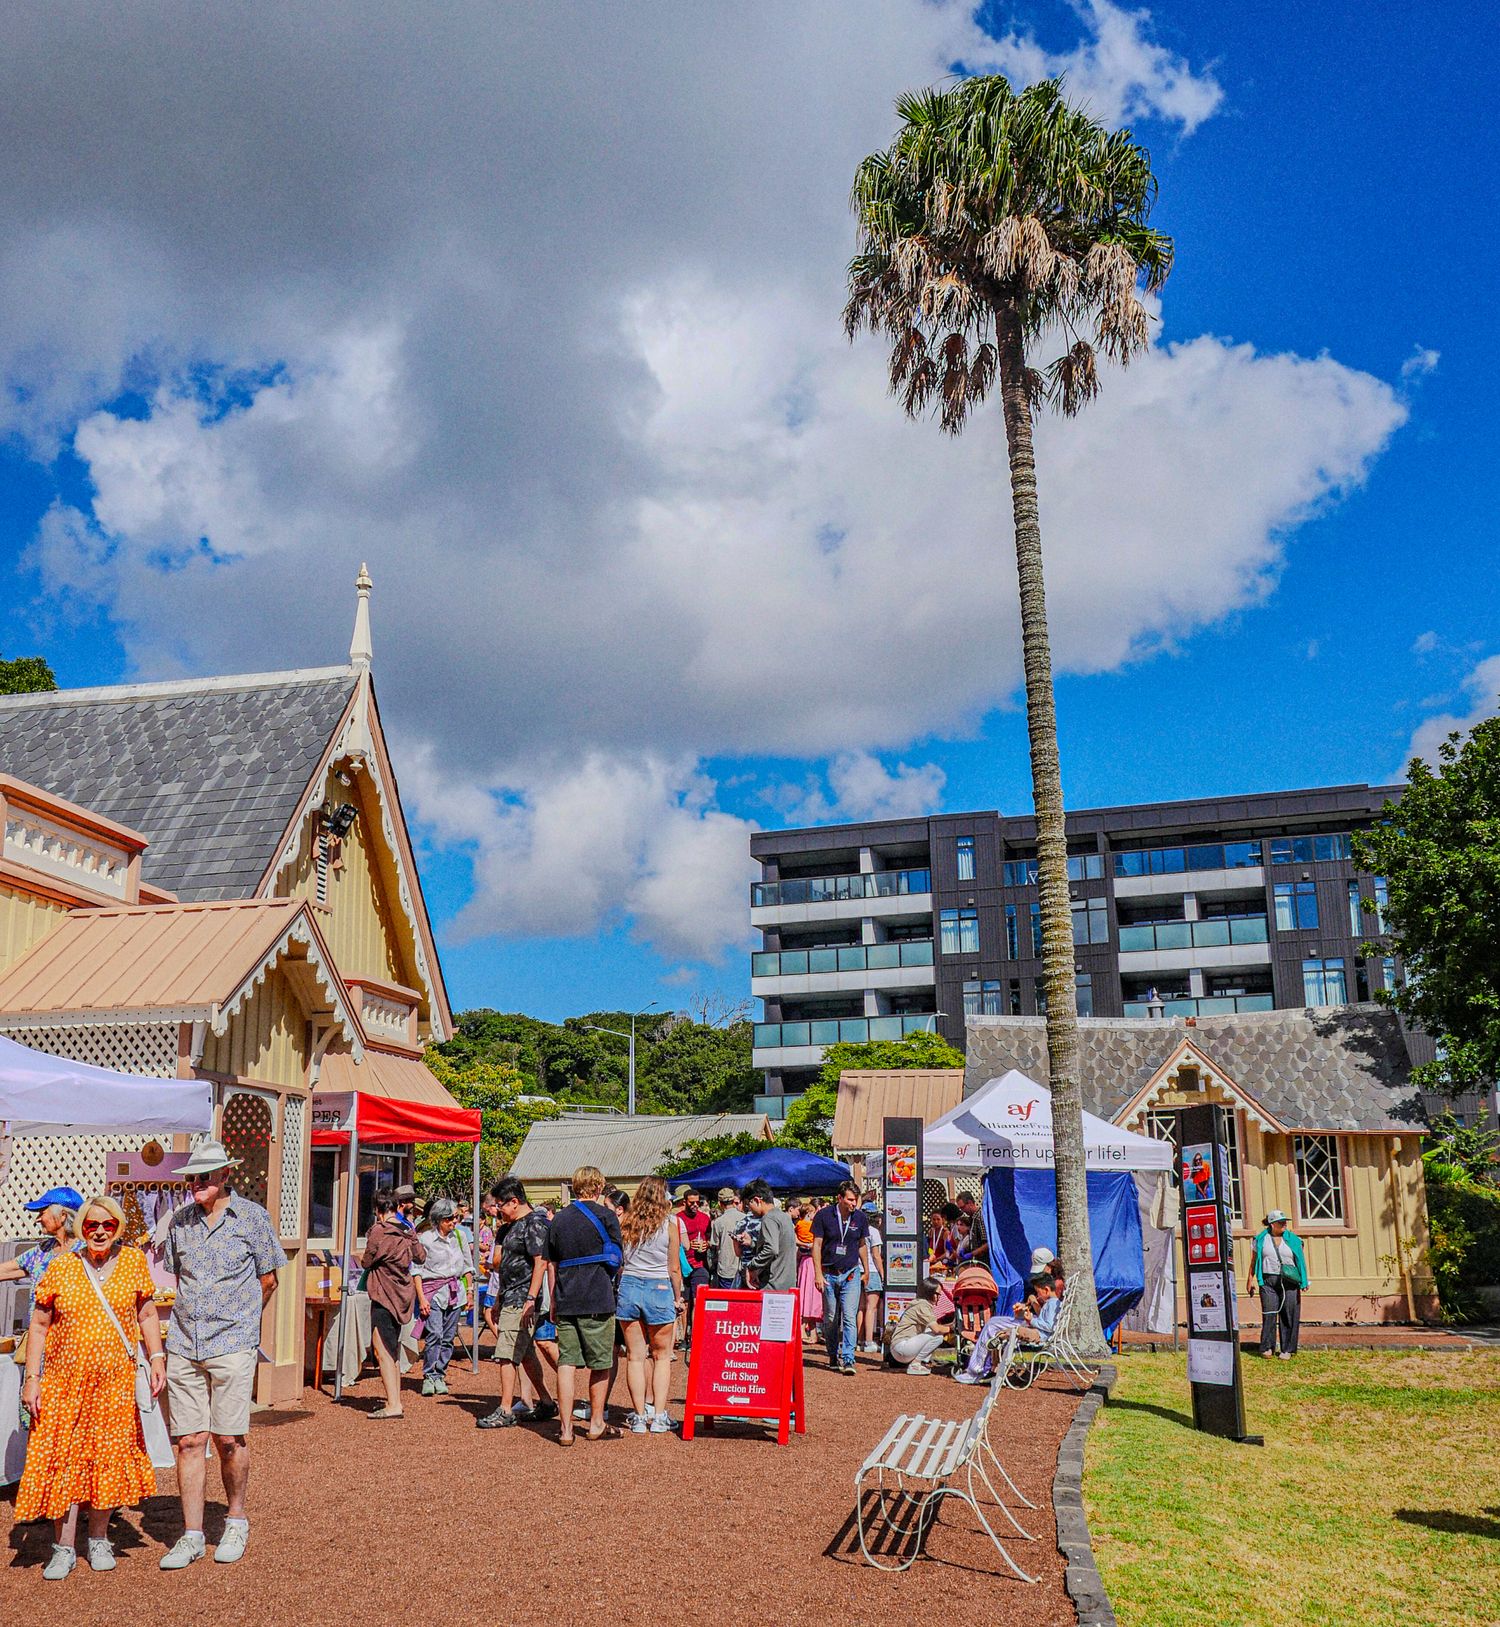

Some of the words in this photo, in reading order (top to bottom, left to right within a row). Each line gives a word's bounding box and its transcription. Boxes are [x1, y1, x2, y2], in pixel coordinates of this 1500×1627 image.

[1007, 1099, 1040, 1121] af
[977, 1143, 1030, 1158] French
[1035, 1148, 1055, 1163] up
[1097, 1145, 1127, 1161] life!
[715, 1320, 760, 1338] Highw
[725, 1341, 760, 1354] OPEN
[724, 1359, 758, 1369] Museum
[721, 1371, 738, 1381] Gift
[739, 1372, 759, 1383] Shop
[712, 1382, 747, 1393] Function
[748, 1384, 766, 1394] Hire
